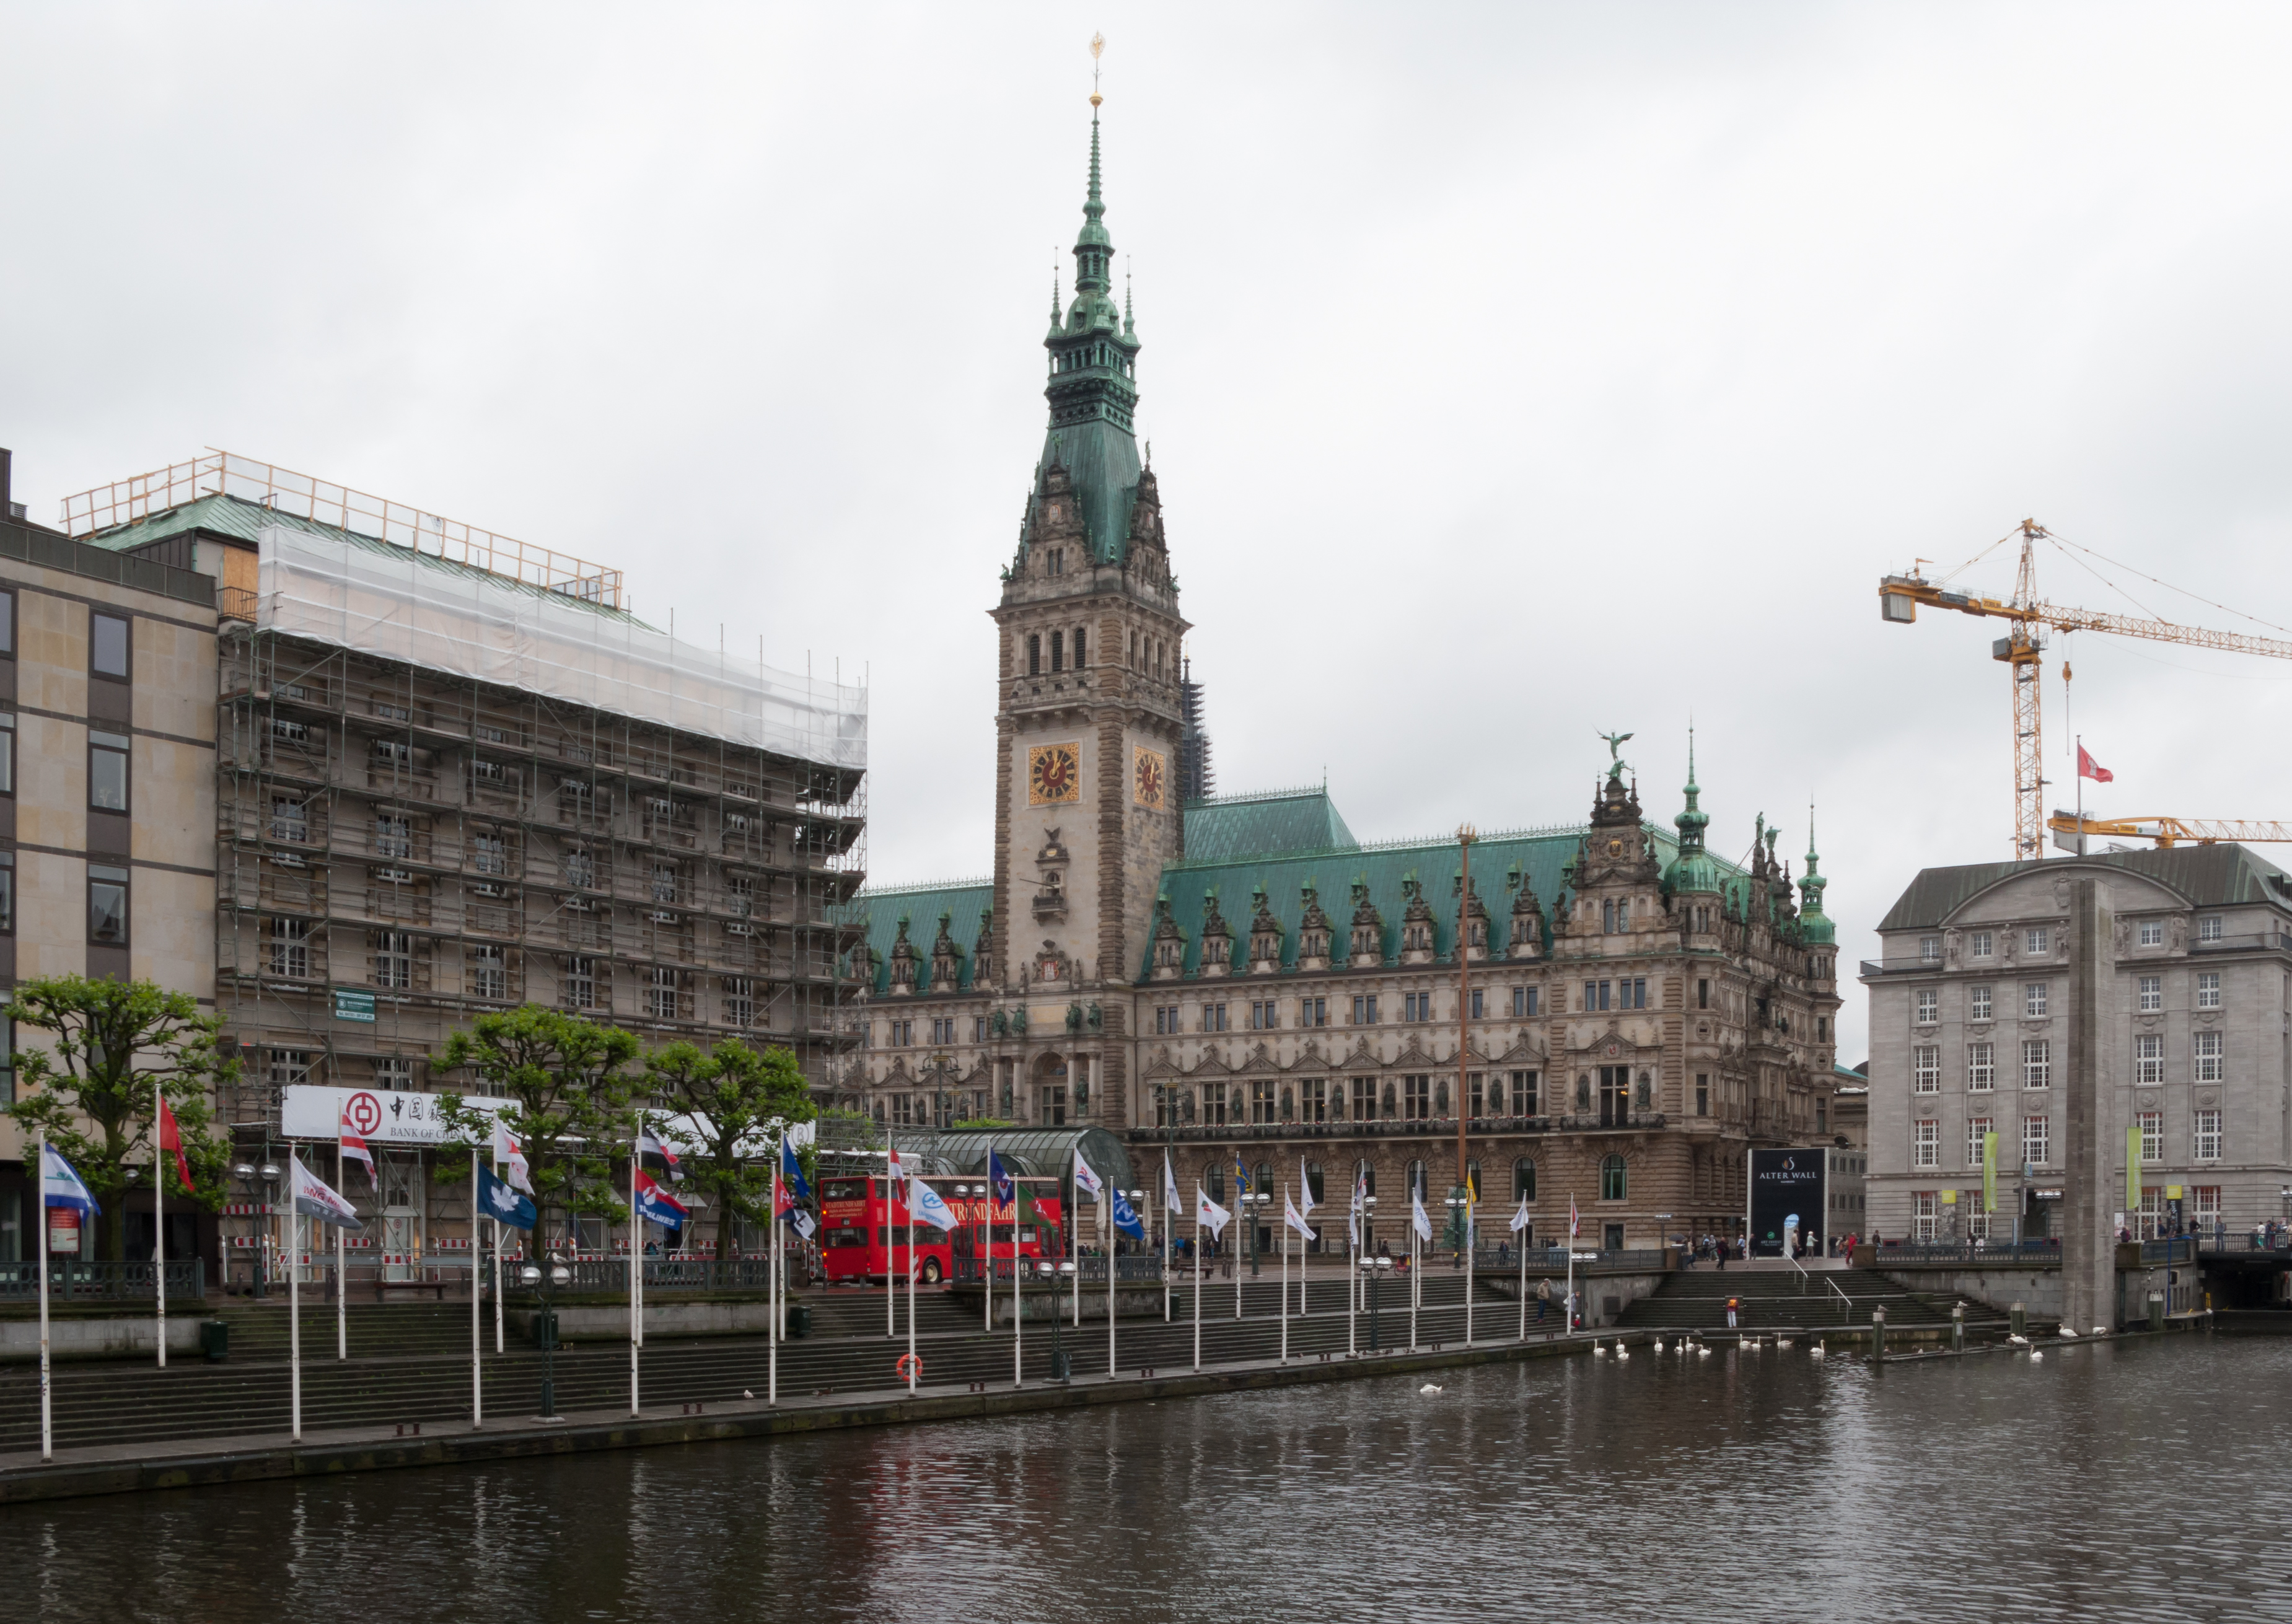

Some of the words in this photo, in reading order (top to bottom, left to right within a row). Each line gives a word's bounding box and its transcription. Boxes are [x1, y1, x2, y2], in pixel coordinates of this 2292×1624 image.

[390, 1127, 418, 1138] BANK
[421, 1128, 434, 1138] OF
[825, 1200, 866, 1208] STADTRUNDFAHRT
